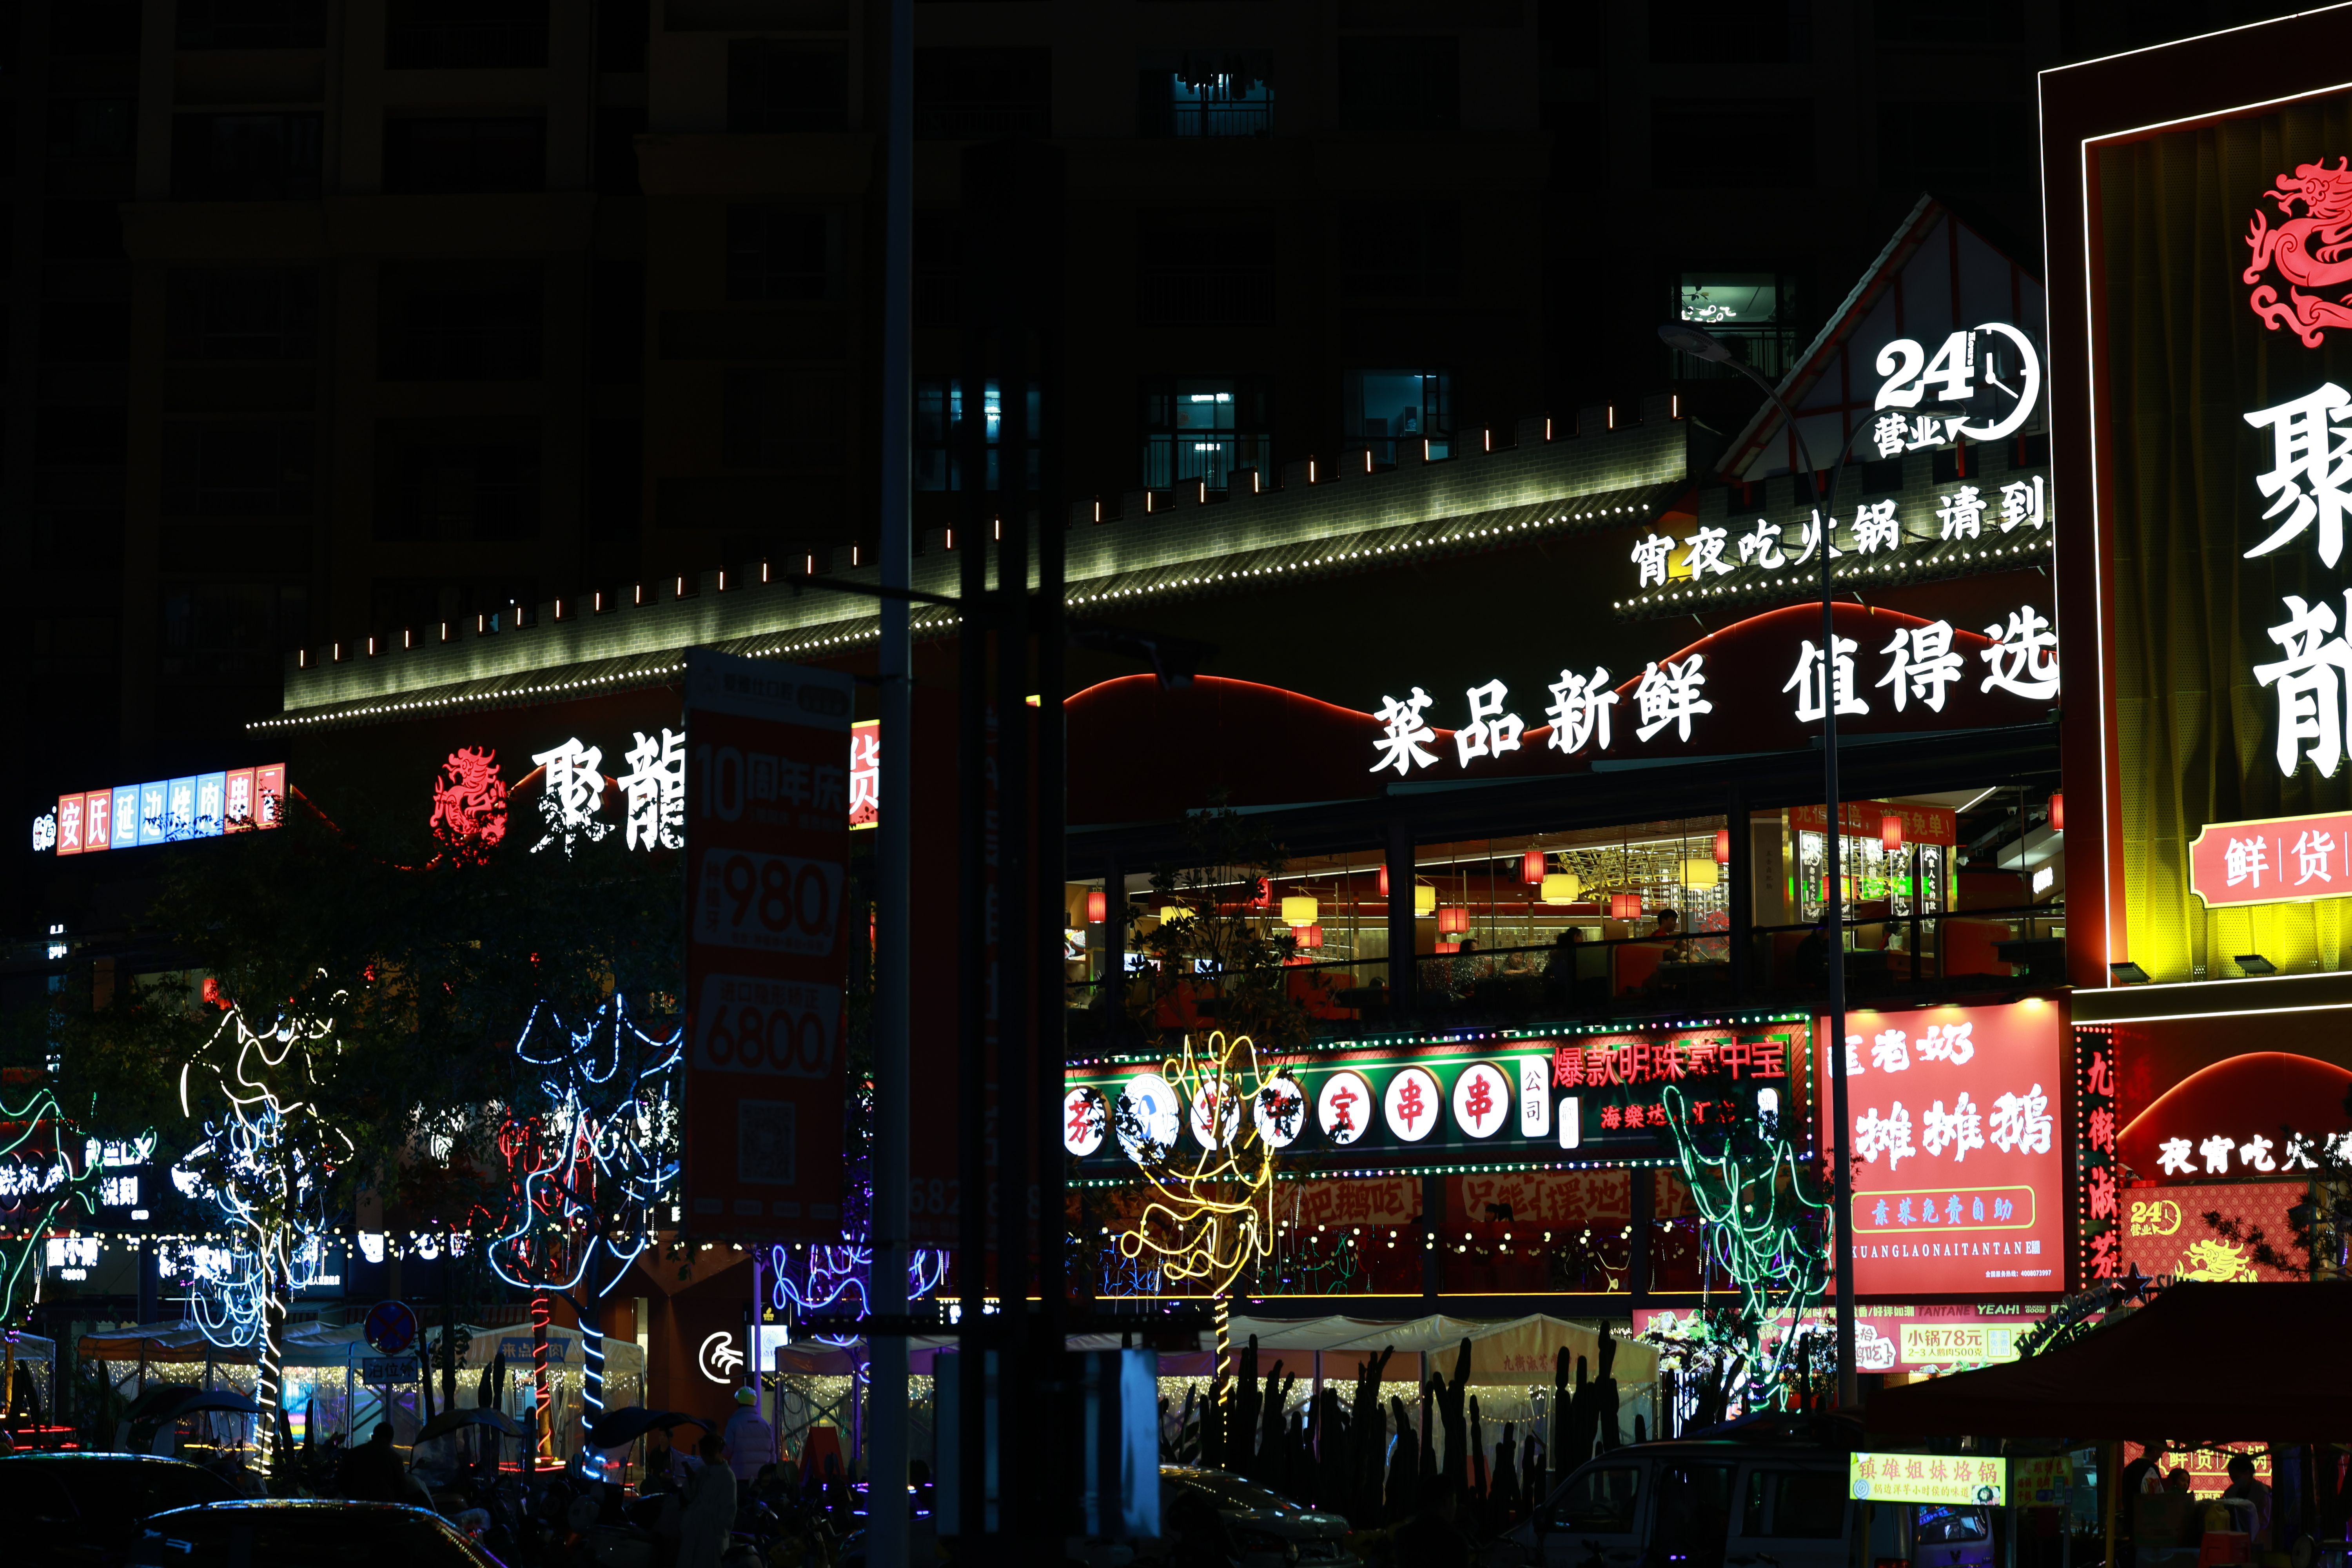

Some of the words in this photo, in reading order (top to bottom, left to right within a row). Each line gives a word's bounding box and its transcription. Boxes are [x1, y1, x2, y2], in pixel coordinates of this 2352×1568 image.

[1968, 331, 1976, 366] Hours
[1875, 330, 1974, 411] 24
[1874, 412, 1946, 459] 营业
[1631, 499, 1898, 588] 宵夜吃火锅
[1936, 475, 2045, 540] 请到
[1369, 654, 1713, 776] 菜品新鲜
[1783, 606, 2060, 723] 值得选
[695, 743, 844, 822] 10周年庆
[724, 855, 829, 936] 980
[1897, 858, 1907, 908] 天天排队
[1928, 858, 1936, 915] 家人吃的放
[707, 1004, 825, 1073] 6800
[1525, 1069, 1542, 1121] 公司
[1872, 1194, 2013, 1226] 素菜免费自助
[2130, 1224, 2152, 1237] 营业
[2131, 1201, 2162, 1223] 24
[1918, 1306, 1970, 1317] TANTANE
[1977, 1305, 2020, 1314] YEAH!
[502, 1342, 564, 1358] 来点肉
[1908, 1330, 1982, 1347] 小锅78元
[368, 1362, 414, 1378] 泊位外
[1859, 1457, 1997, 1483] 镇雄姐妹烙锅
